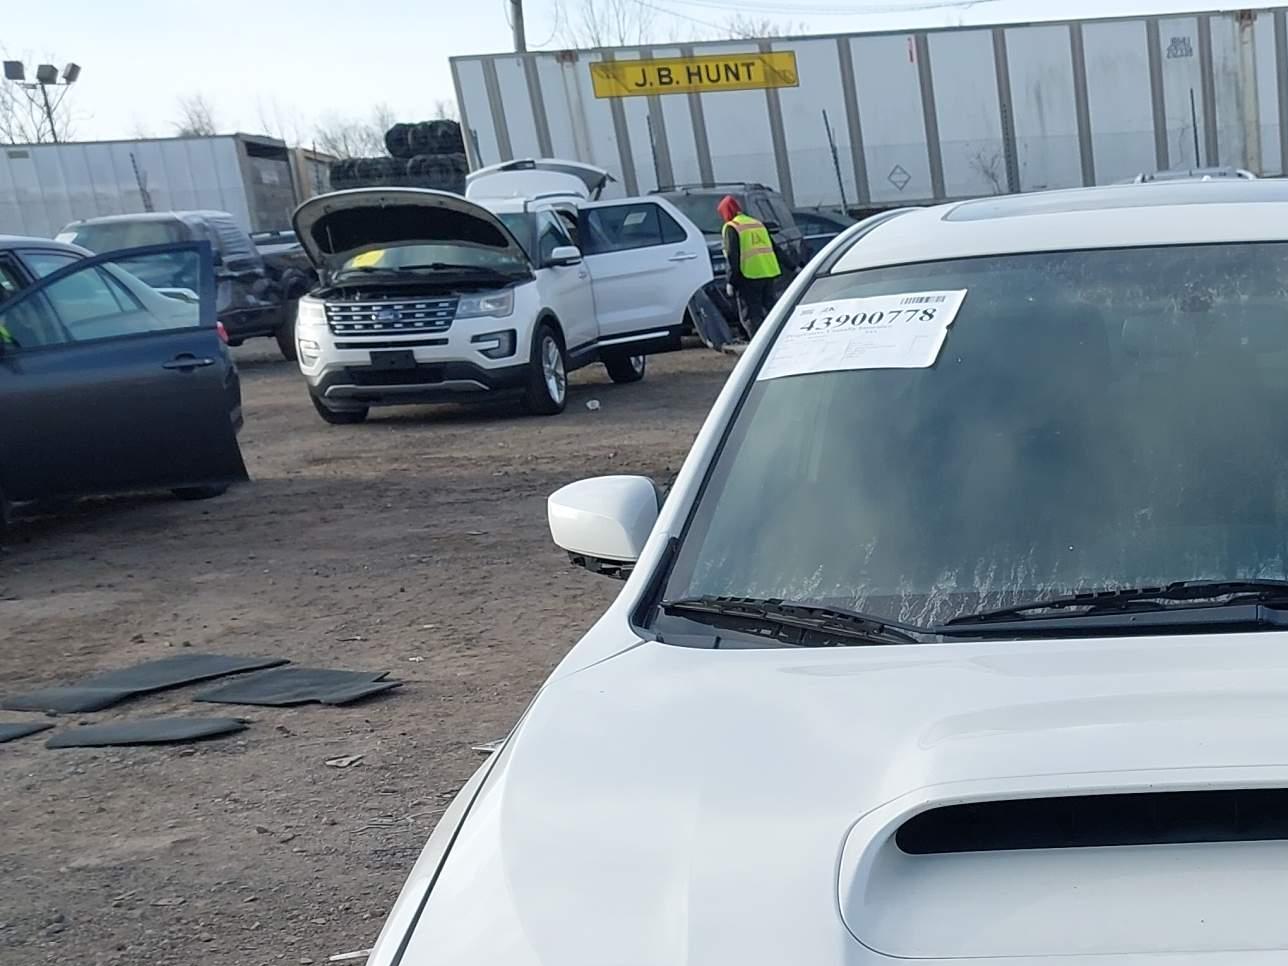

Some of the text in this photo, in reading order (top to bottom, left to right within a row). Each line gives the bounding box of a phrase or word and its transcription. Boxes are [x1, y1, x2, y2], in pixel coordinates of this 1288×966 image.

[635, 61, 755, 87] J.B. HUNT
[800, 308, 937, 332] 43900778
